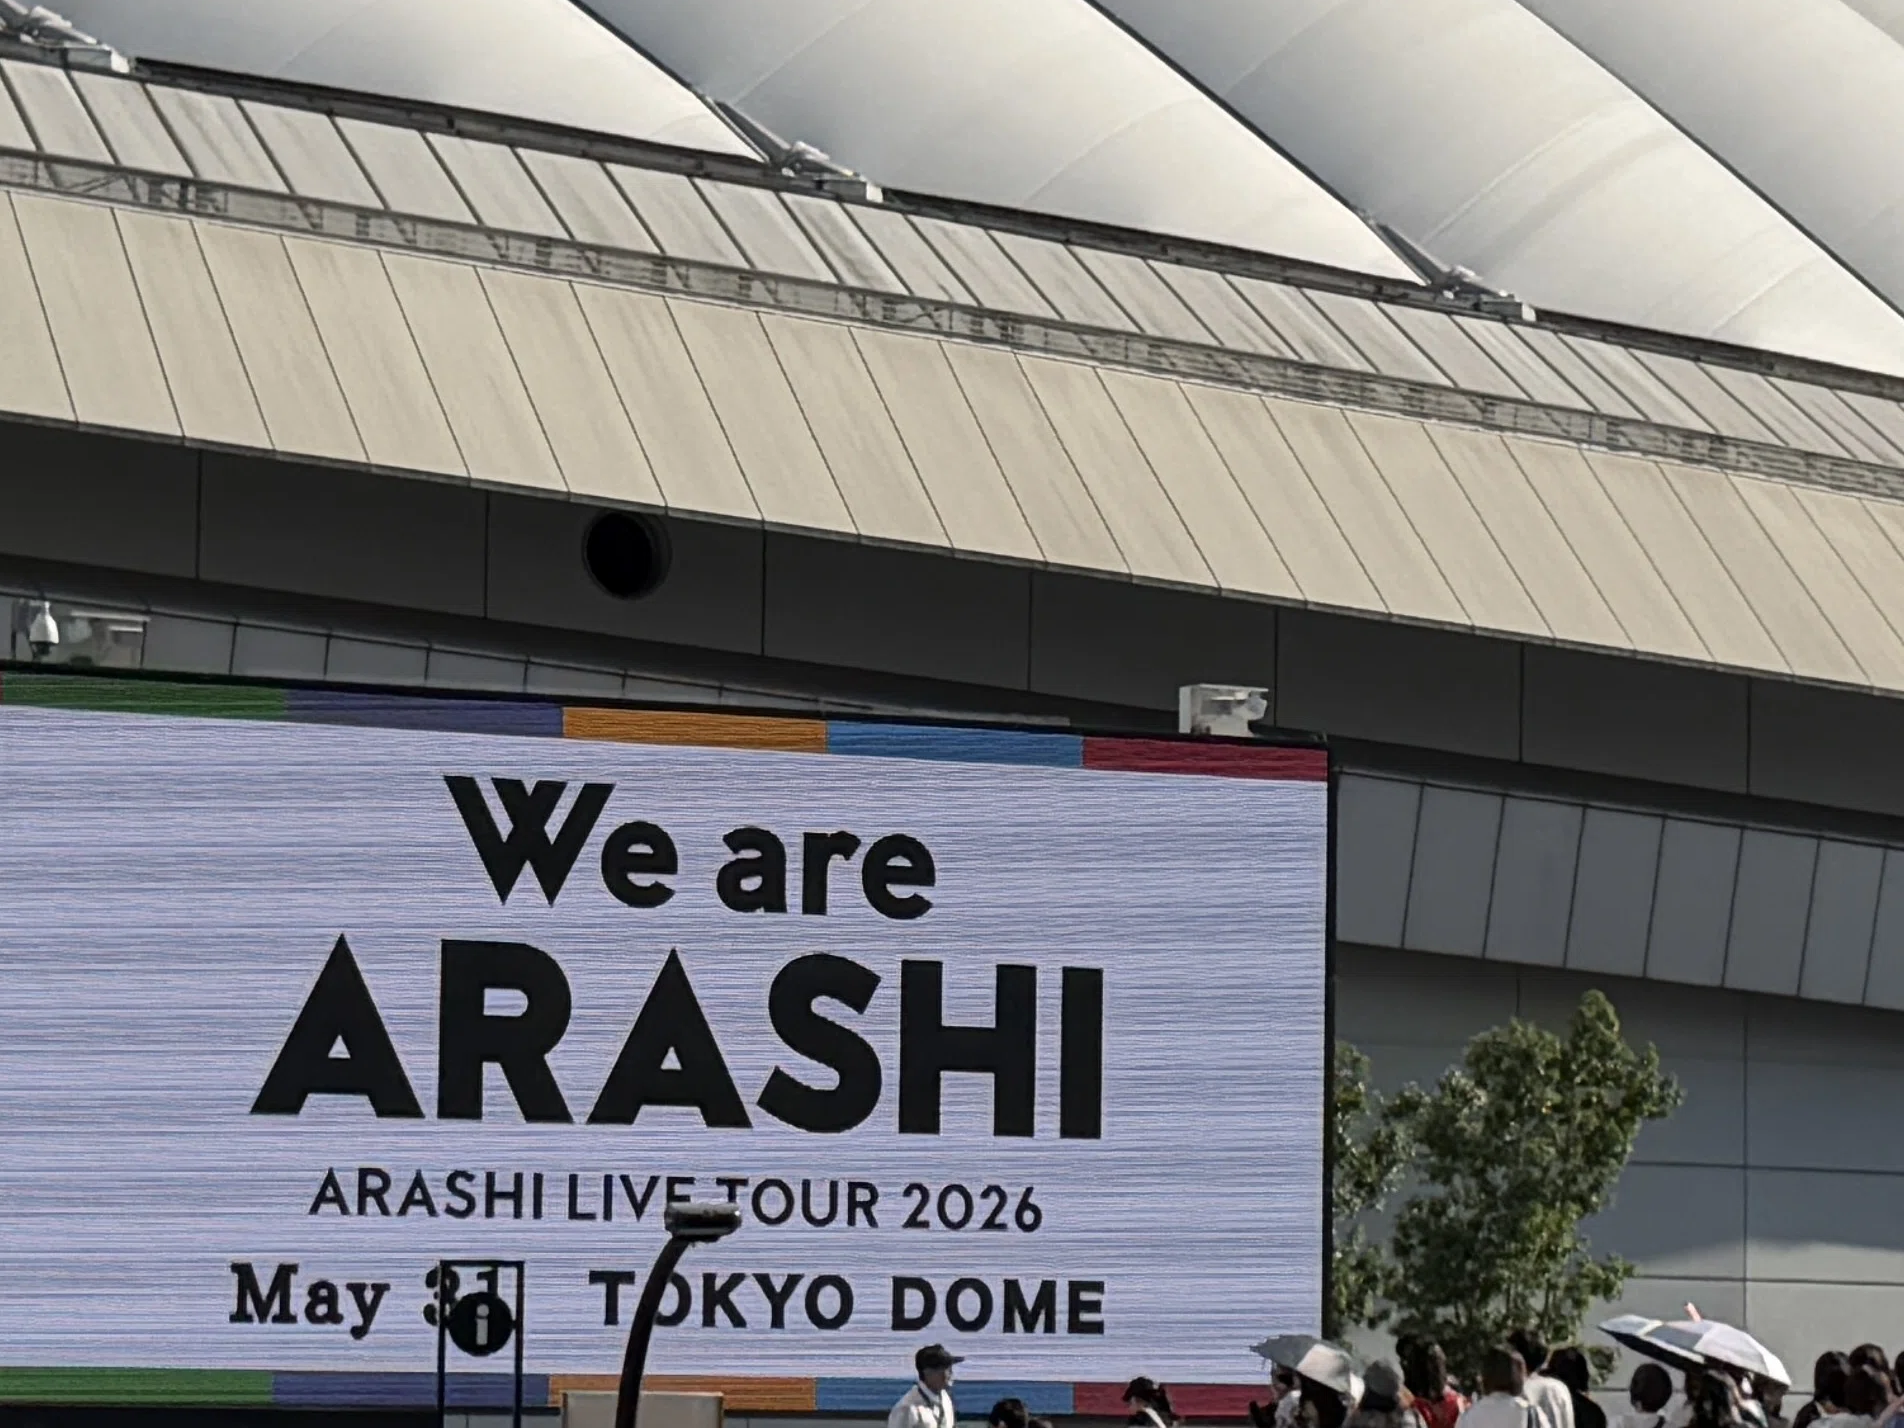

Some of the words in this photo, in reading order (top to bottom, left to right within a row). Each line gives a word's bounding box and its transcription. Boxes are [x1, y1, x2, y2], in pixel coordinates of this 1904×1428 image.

[442, 774, 679, 910] We
[714, 825, 937, 922] are
[248, 933, 1105, 1141] ARASHI
[307, 1166, 545, 1221] ARASHI
[716, 1176, 881, 1230] TOUR
[901, 1181, 1045, 1234] 2026
[227, 1260, 392, 1342] May
[587, 1268, 855, 1332] TOKYO
[890, 1274, 1106, 1336] DOME
